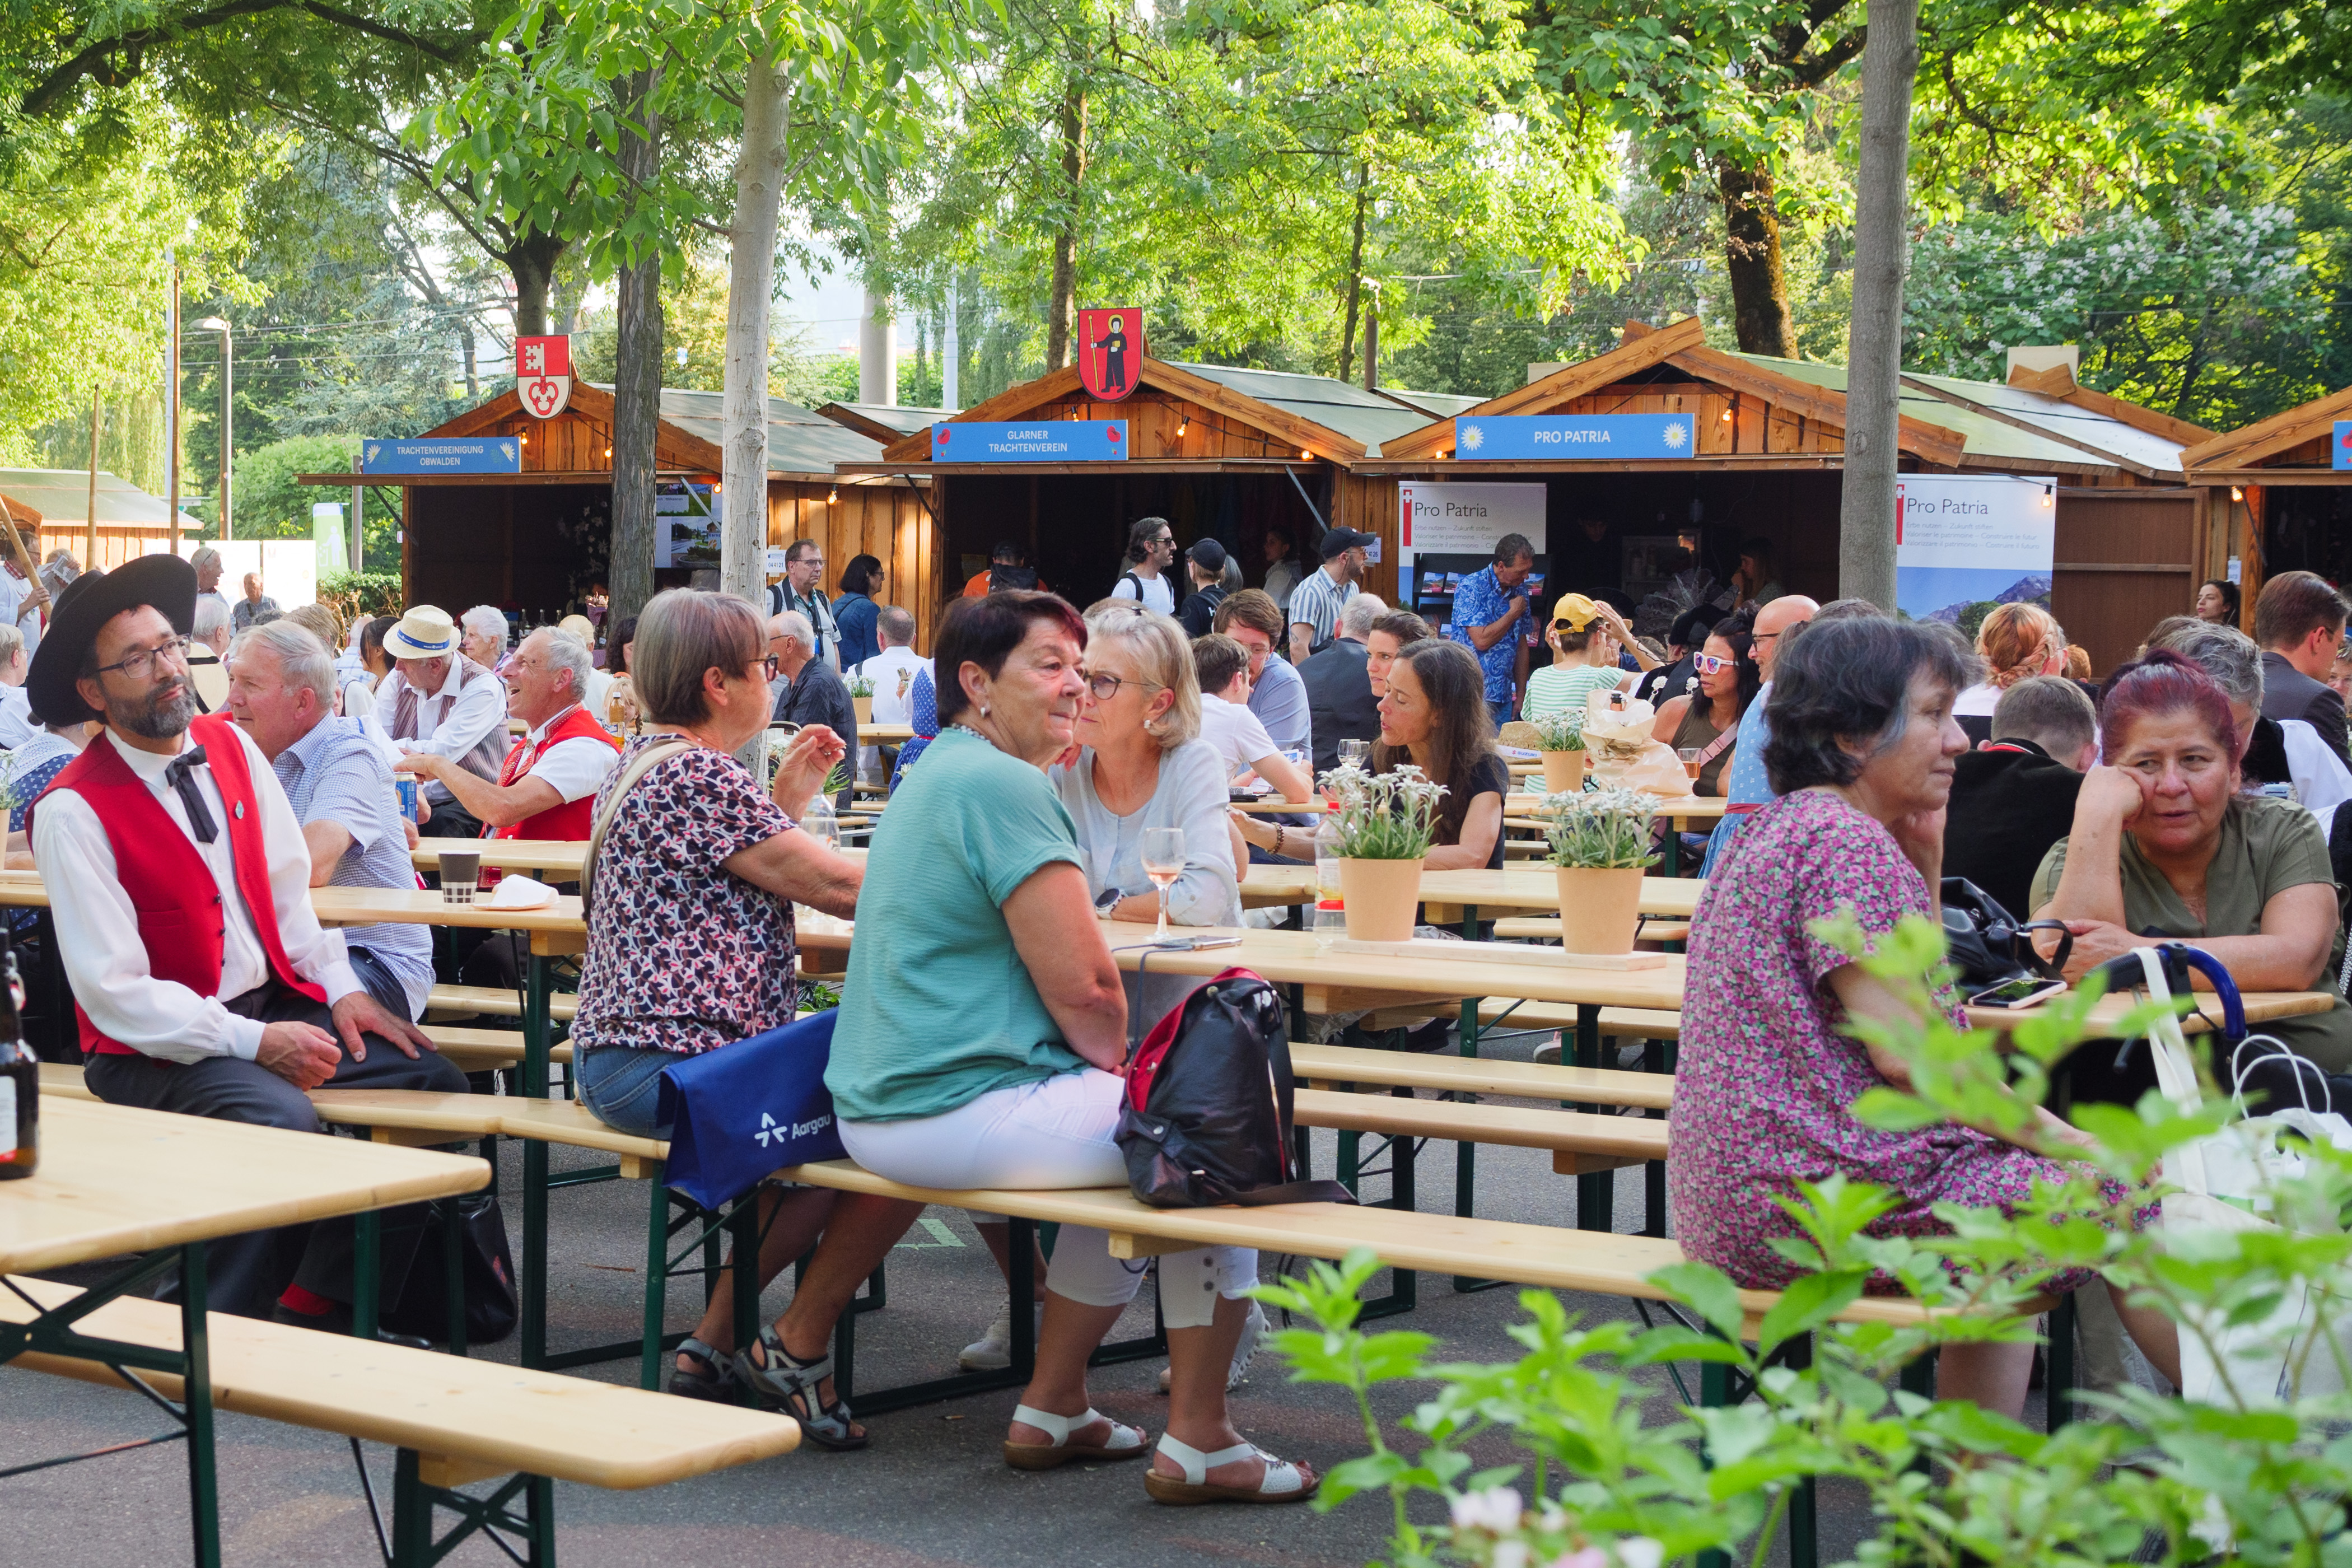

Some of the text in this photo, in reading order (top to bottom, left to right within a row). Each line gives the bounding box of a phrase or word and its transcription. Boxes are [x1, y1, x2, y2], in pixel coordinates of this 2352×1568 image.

[1007, 430, 1048, 440] GLARNER
[1534, 430, 1611, 443] PRO PATRIA
[396, 445, 484, 455] TRACHTENVEREINIGUNG
[988, 443, 1067, 452] TRACHTENVEREIN
[419, 457, 460, 466] OBWALDEN
[1415, 502, 1487, 517] Pro Patria
[1907, 498, 1989, 515] Pro Patria
[792, 1114, 830, 1140] Aargau
